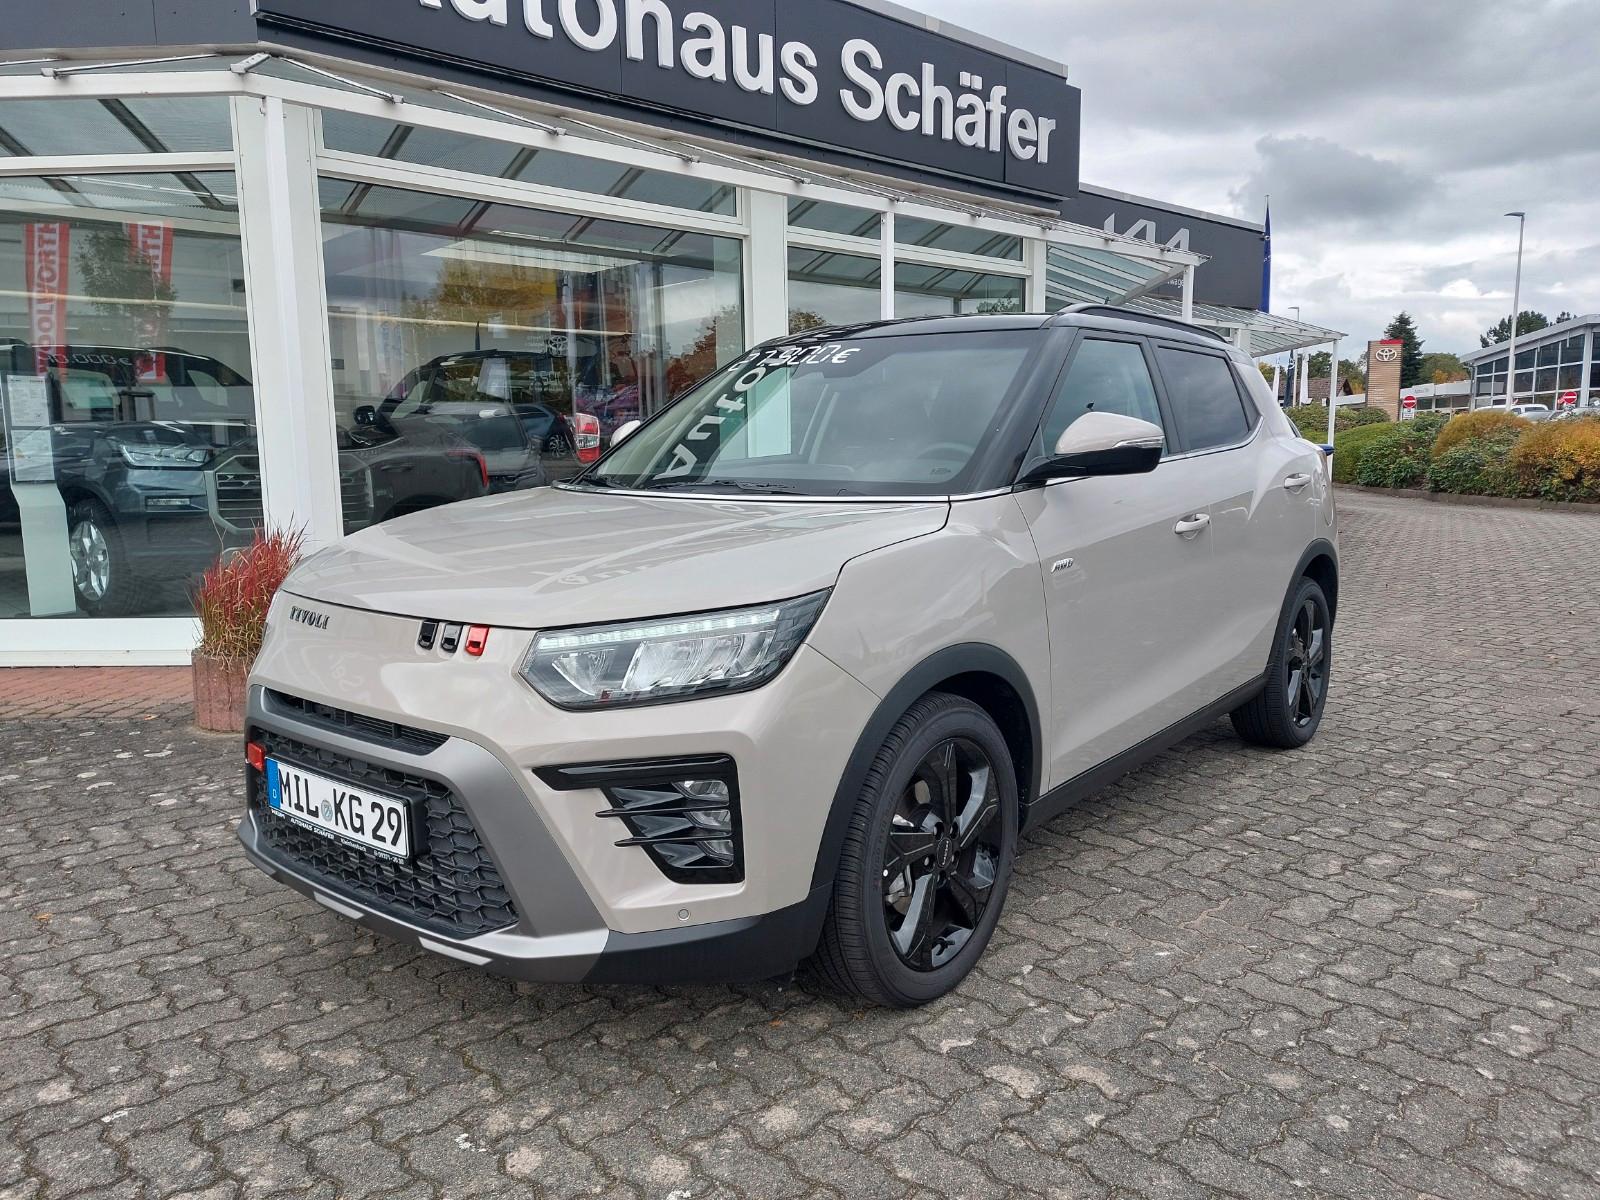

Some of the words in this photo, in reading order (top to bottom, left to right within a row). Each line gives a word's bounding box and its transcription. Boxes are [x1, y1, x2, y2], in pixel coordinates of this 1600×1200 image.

[840, 38, 1057, 164] Schäfer
[290, 606, 330, 630] TIVOLI
[278, 768, 320, 819] MIL
[333, 788, 365, 836] KG
[371, 801, 404, 847] 29
